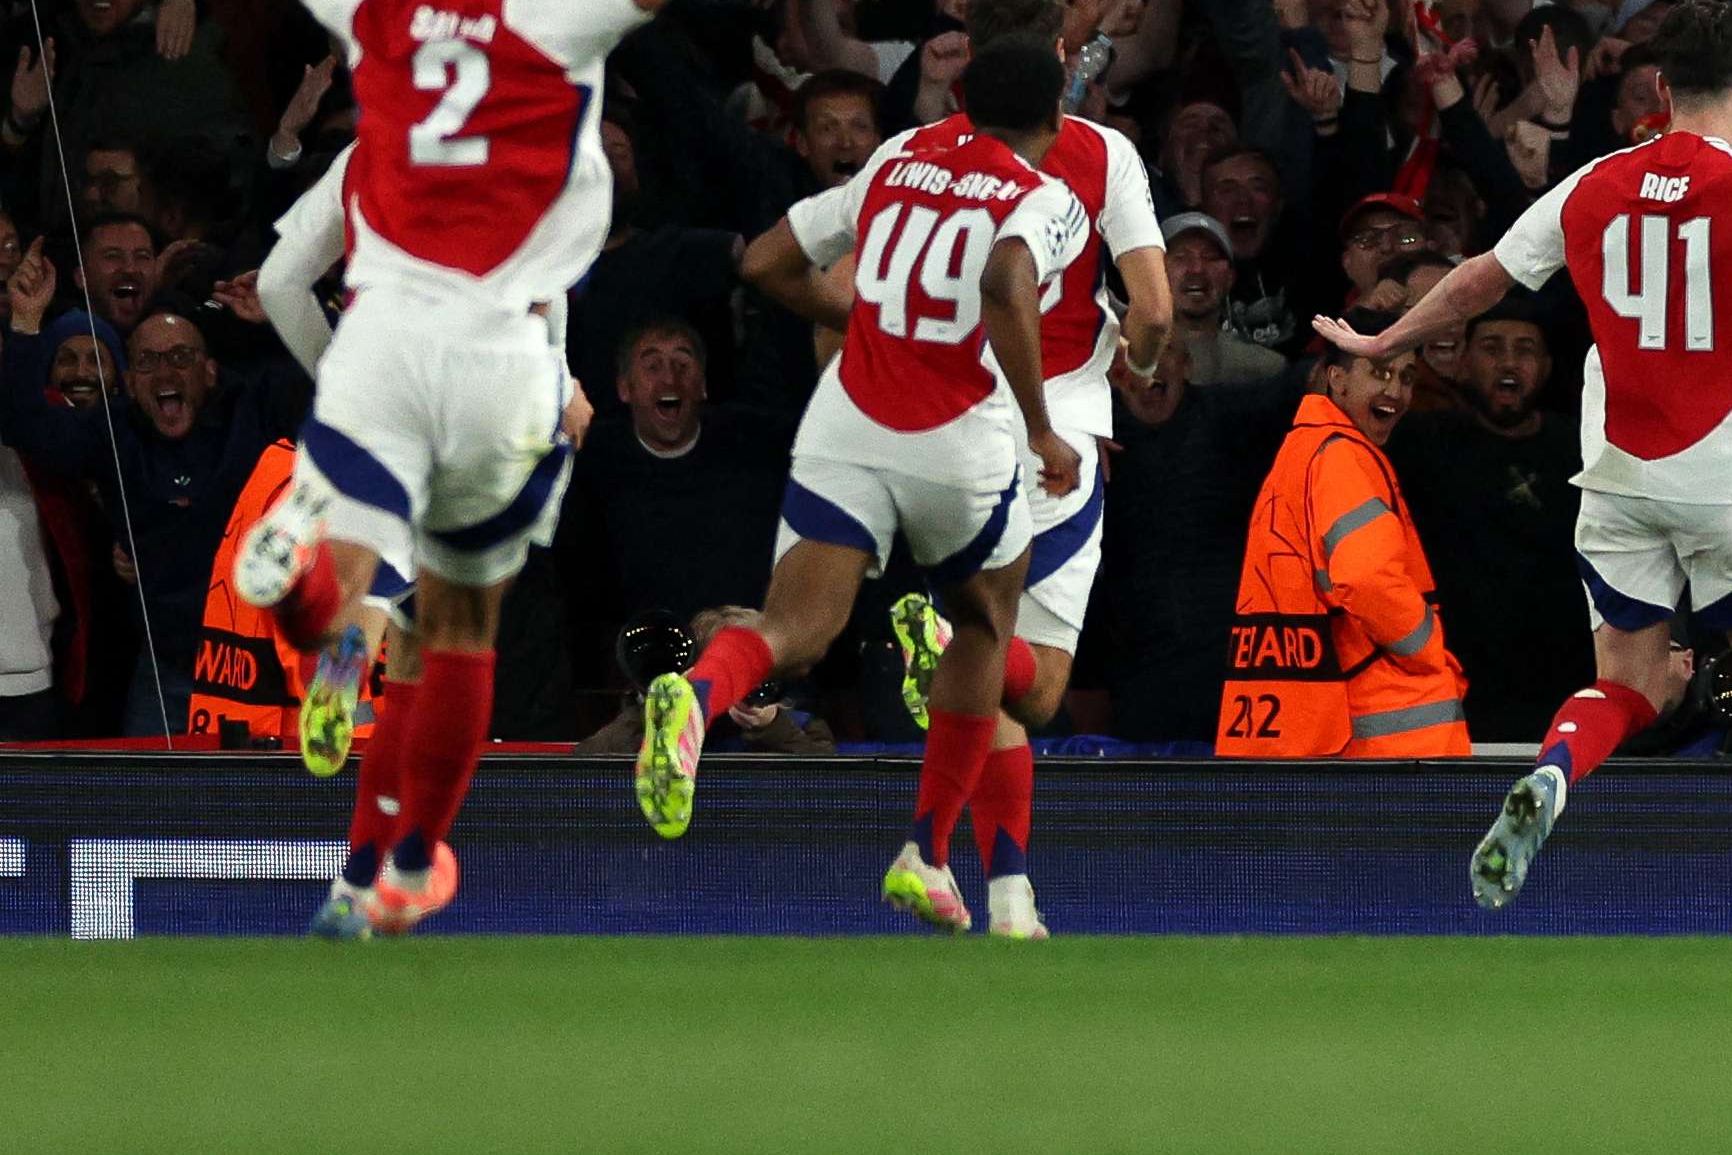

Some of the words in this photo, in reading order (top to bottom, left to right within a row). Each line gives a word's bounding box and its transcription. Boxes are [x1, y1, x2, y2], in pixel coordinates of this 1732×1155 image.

[409, 40, 491, 166] 2
[1639, 172, 1690, 202] RICE
[855, 200, 998, 344] 49
[1601, 213, 1713, 351] 41
